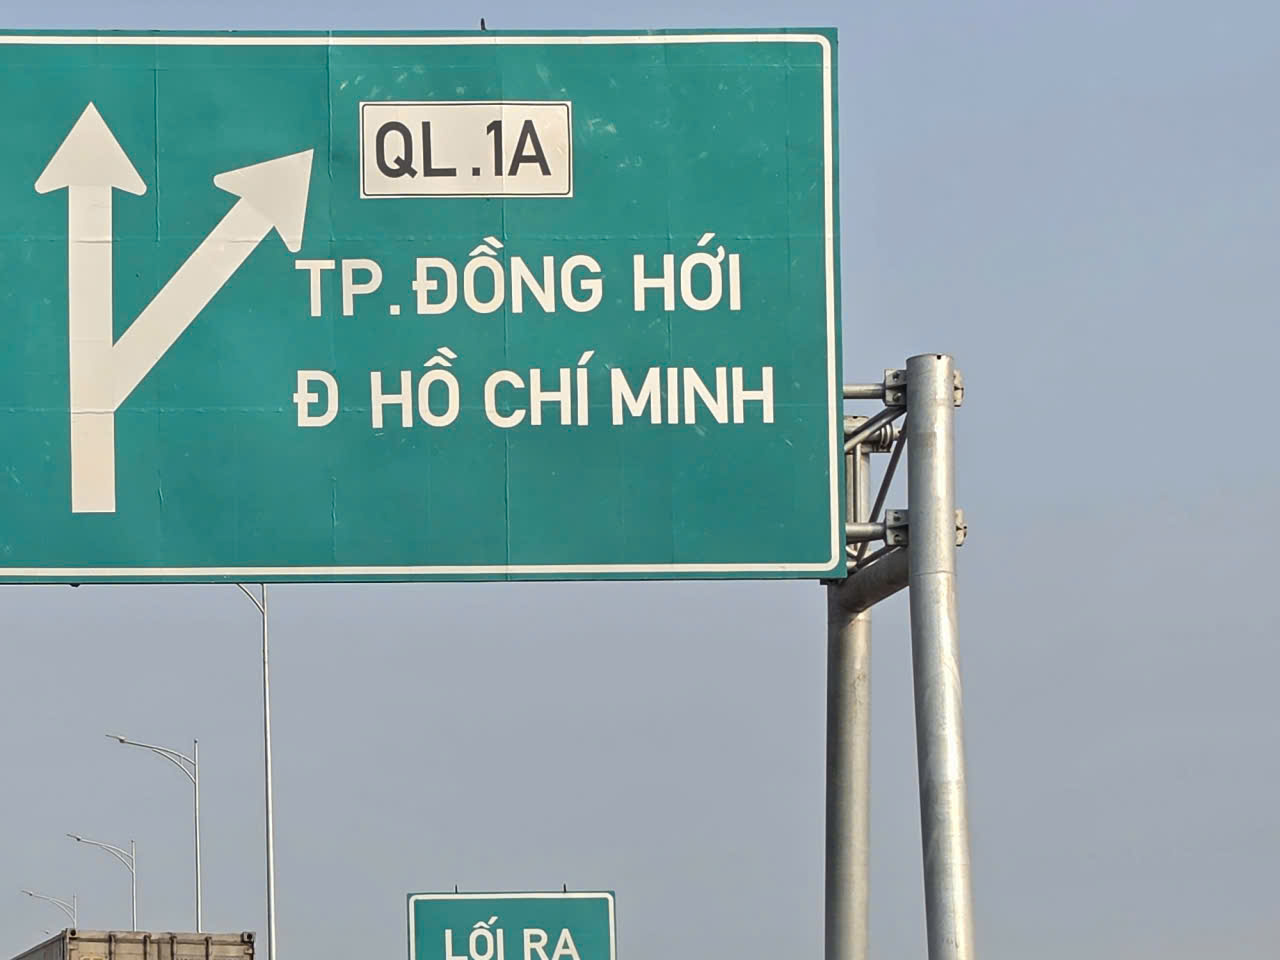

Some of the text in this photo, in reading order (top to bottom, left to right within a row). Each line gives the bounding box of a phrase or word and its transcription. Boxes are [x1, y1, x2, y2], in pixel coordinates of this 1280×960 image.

[634, 232, 742, 312] HỚI
[293, 347, 775, 429] Đ HỒ CHÍ MINH
